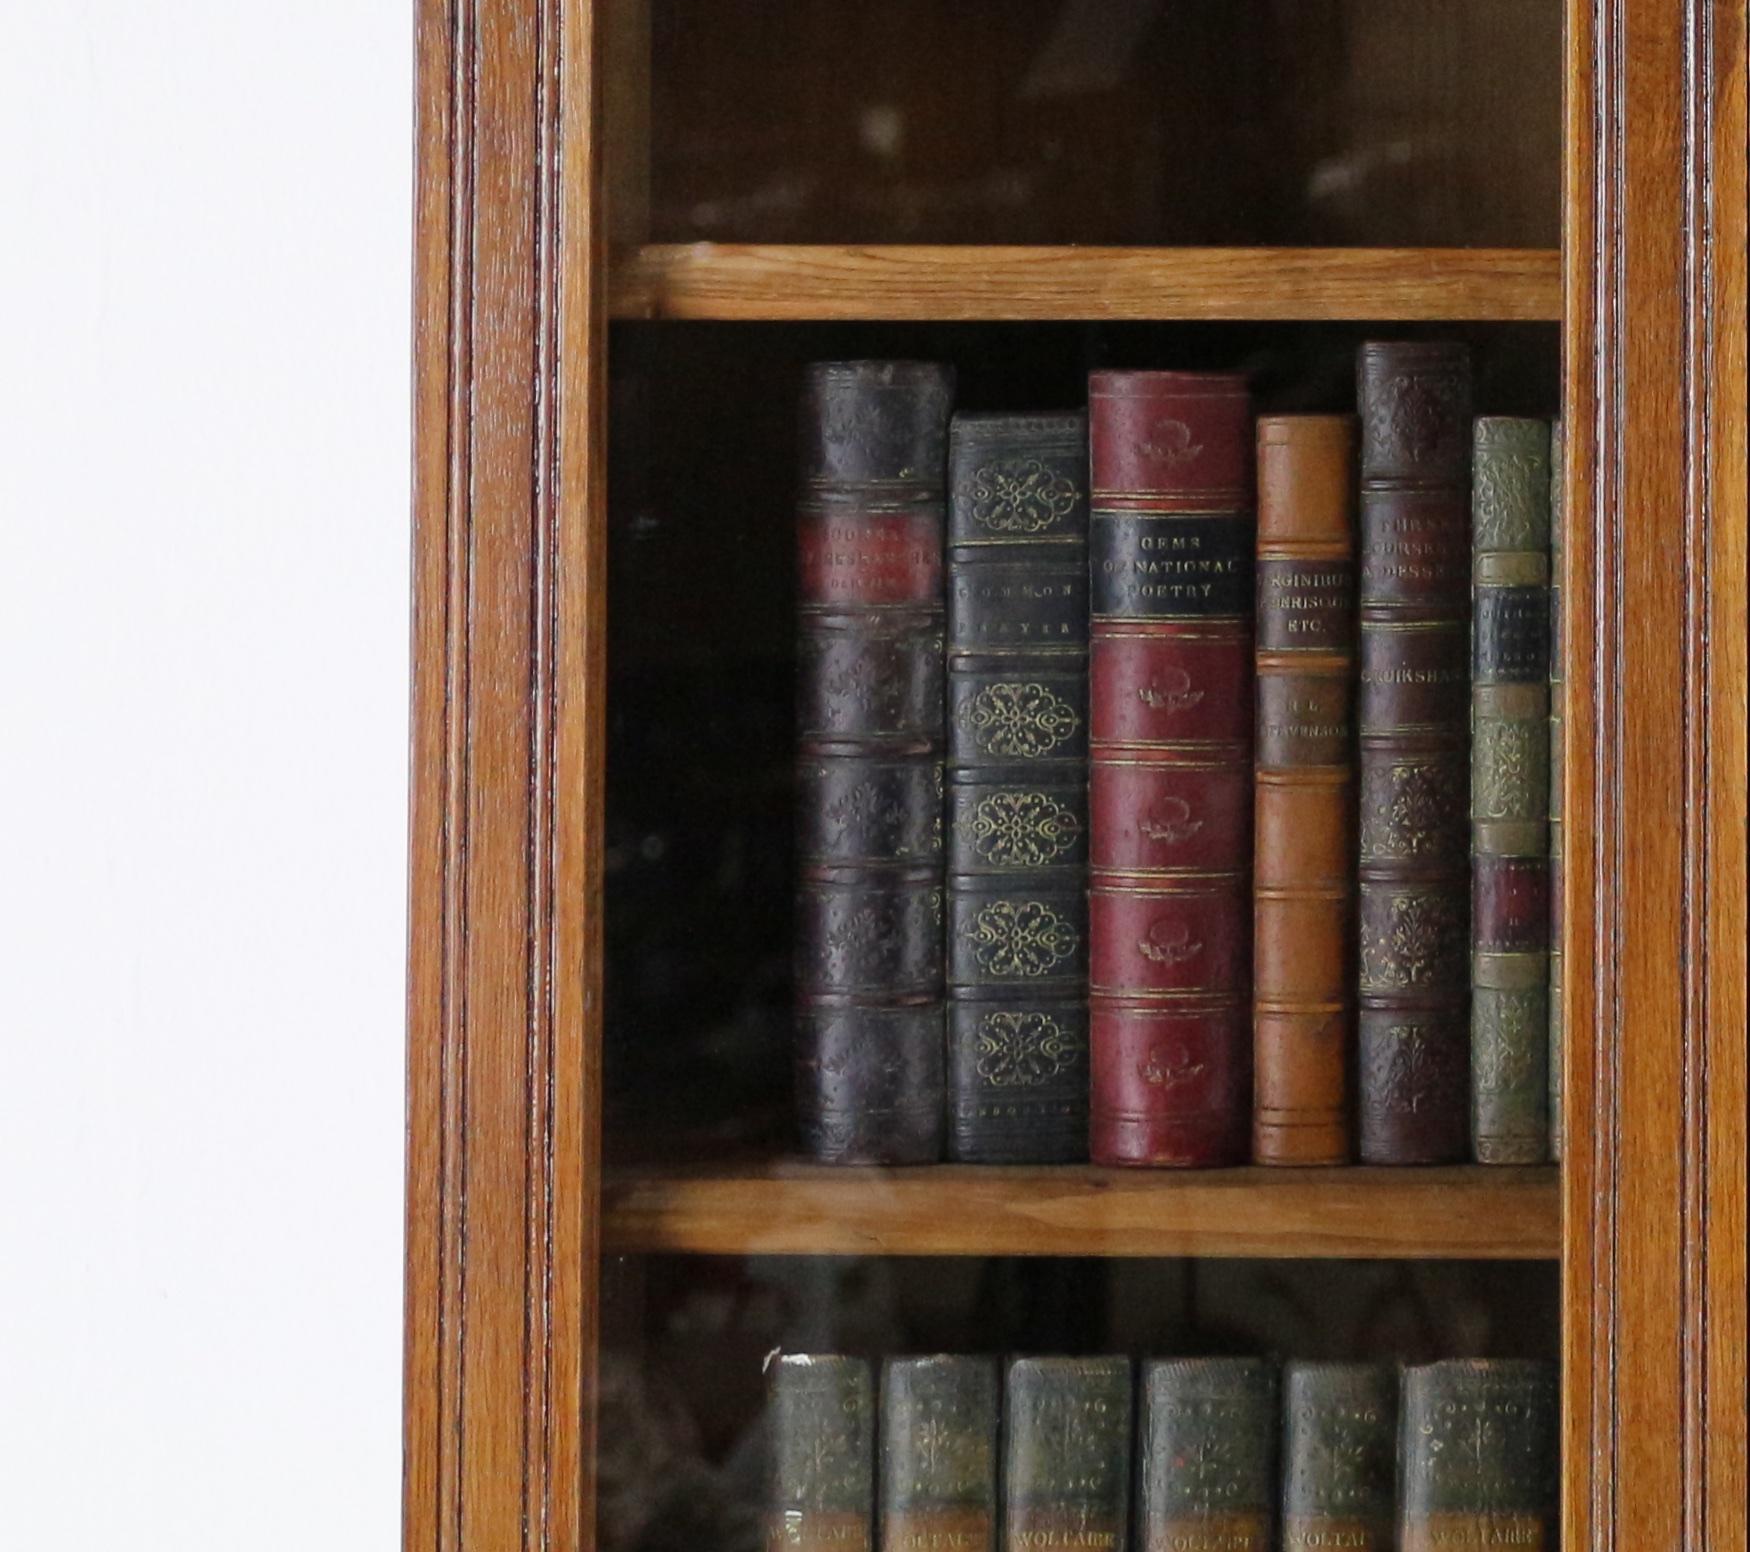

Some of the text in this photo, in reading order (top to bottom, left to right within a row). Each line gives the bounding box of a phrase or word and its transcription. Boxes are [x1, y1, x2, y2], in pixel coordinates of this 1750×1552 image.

[1141, 537, 1200, 550] GEMS
[1132, 559, 1235, 574] NATIONAL
[958, 584, 1072, 598] COMMON
[1129, 584, 1211, 597] POETRY
[1288, 619, 1326, 633] ETC.
[1361, 668, 1463, 683] CRUIKSHA
